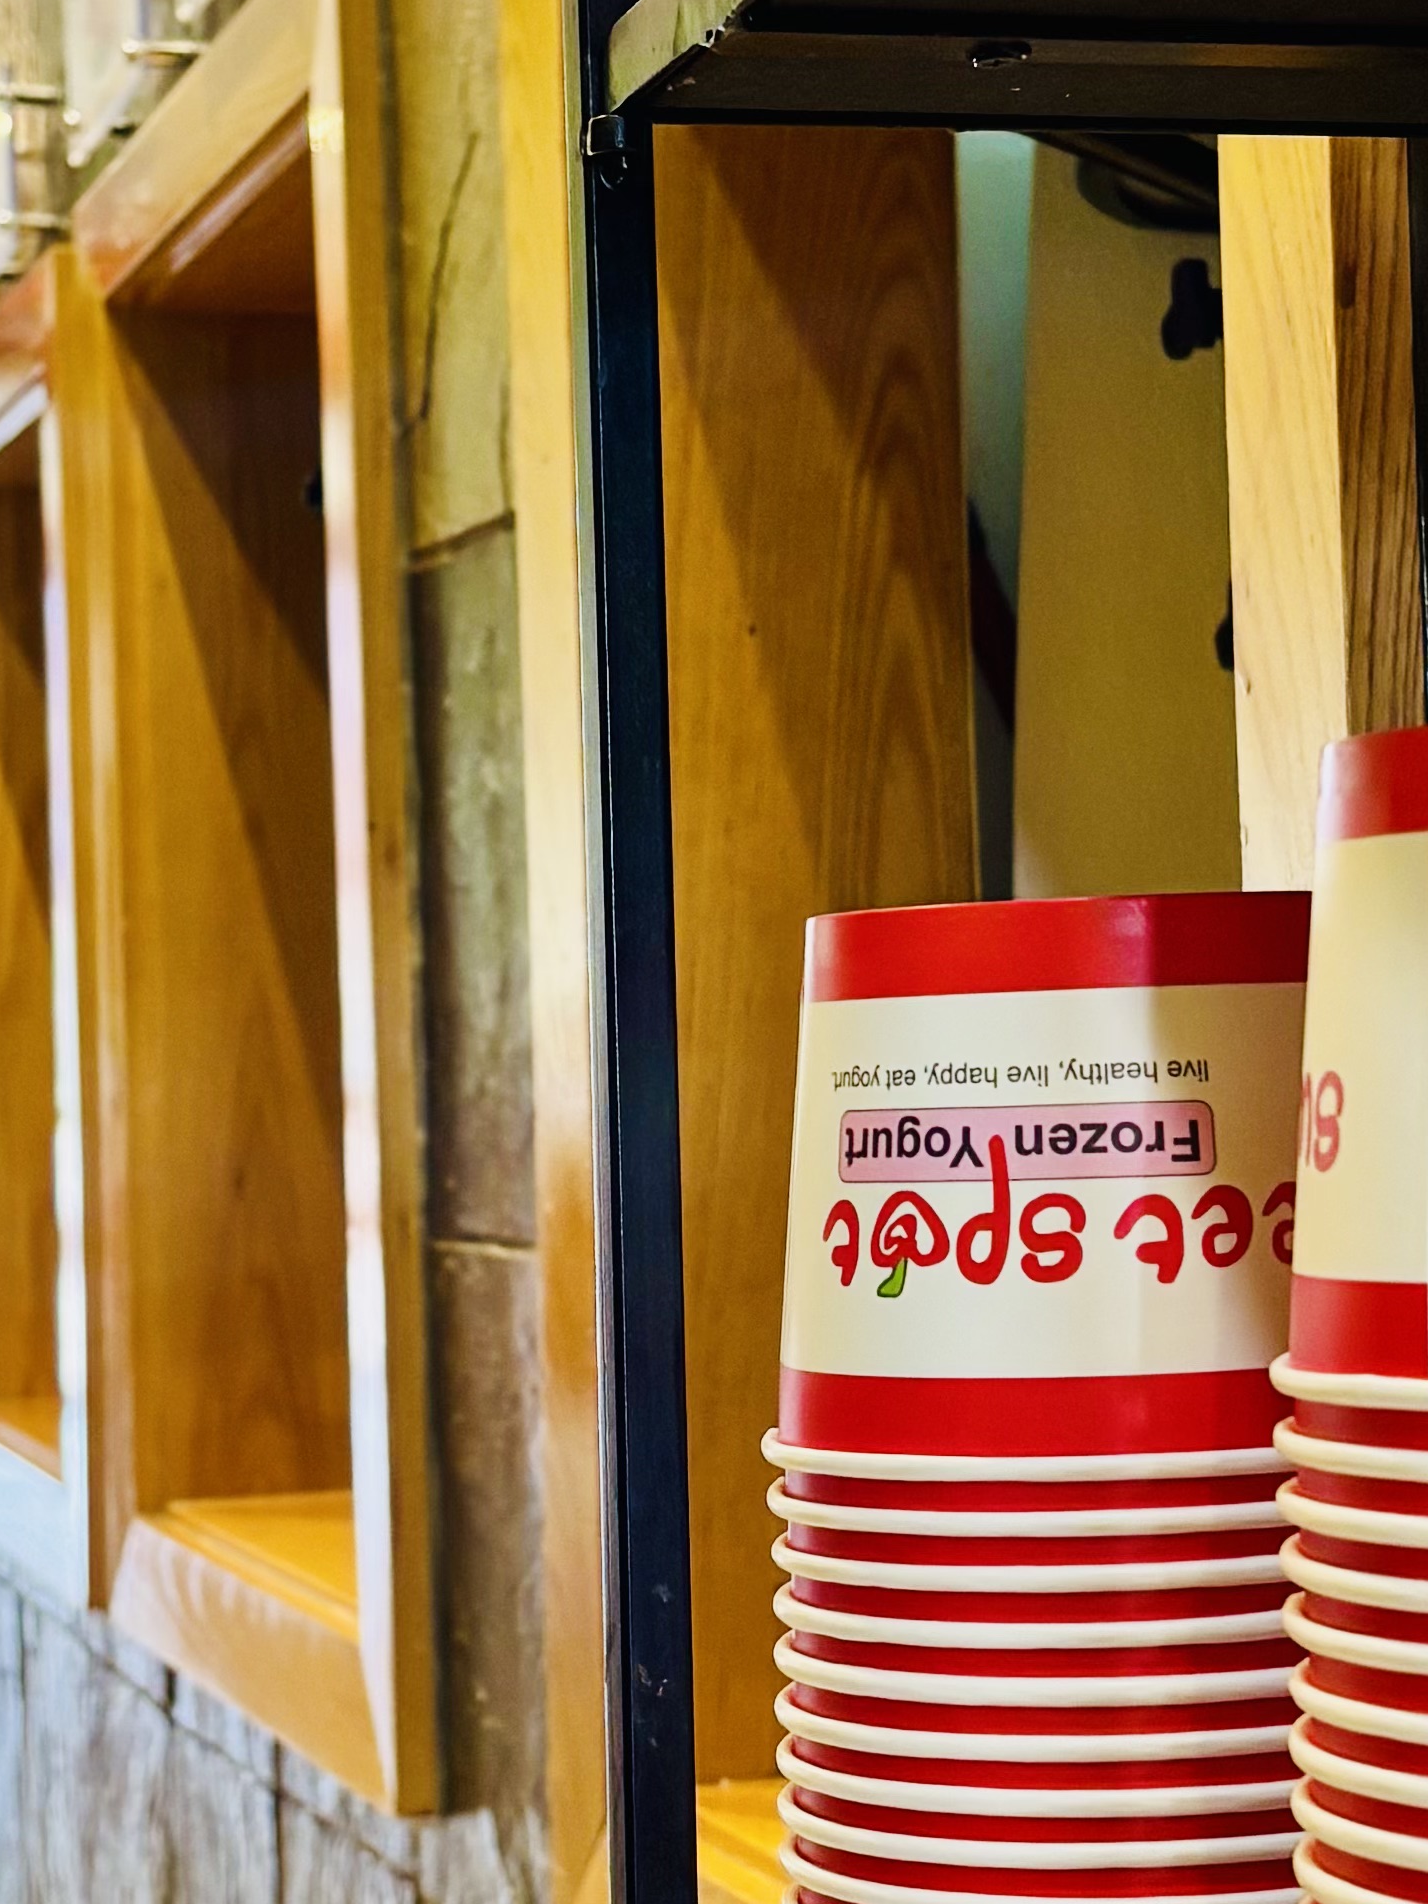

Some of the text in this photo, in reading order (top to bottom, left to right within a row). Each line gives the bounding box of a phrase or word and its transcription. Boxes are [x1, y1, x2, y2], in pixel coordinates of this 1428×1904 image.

[885, 1069, 916, 1091] eat
[923, 1062, 998, 1089] happy,
[1006, 1064, 1049, 1088] live
[1057, 1059, 1157, 1087] healthy,
[1167, 1059, 1209, 1083] live
[844, 1116, 1200, 1168] Frozen Yogurt
[822, 1134, 1295, 1299] eet spot
